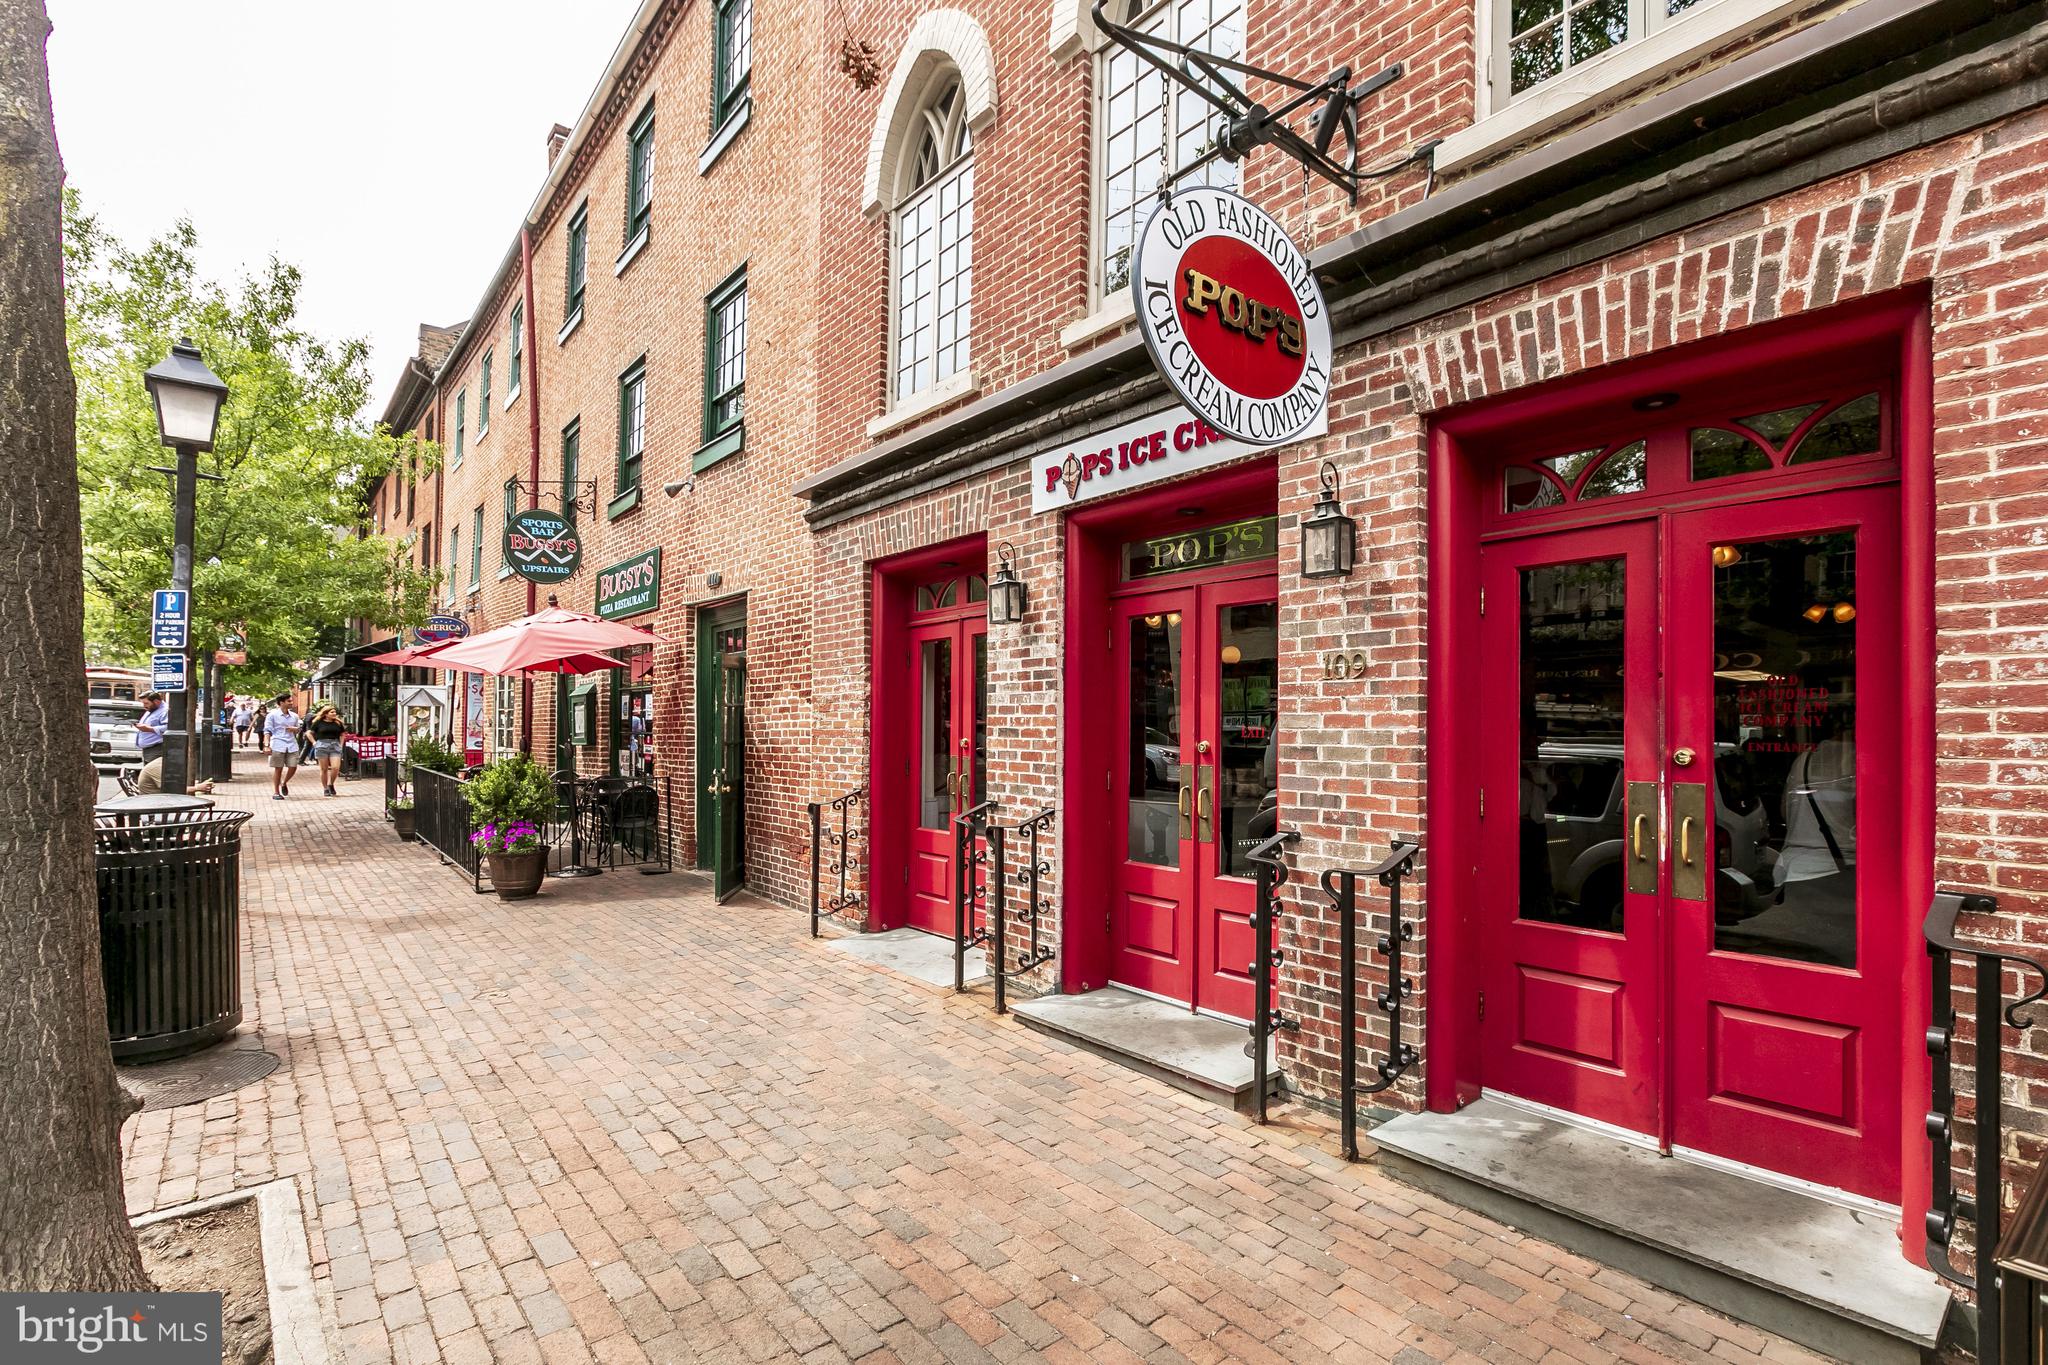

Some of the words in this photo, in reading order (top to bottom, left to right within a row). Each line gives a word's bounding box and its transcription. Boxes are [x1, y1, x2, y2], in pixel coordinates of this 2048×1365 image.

[1162, 199, 1206, 250] OLD
[1214, 197, 1320, 321] FASHIONED
[1184, 268, 1304, 356] POP'S
[1144, 276, 1179, 344] ICE
[1169, 340, 1243, 434] CREAM
[1249, 351, 1328, 438] COMPANY
[1118, 430, 1167, 471] ICE
[522, 518, 563, 530] SPORTS
[531, 527, 555, 536] BAR
[509, 534, 578, 554] BUGSY'S
[1150, 525, 1264, 569] POP'S
[522, 565, 570, 574] UPSTAIRS
[600, 556, 654, 602] BUGSY'S
[614, 591, 650, 611] RESTAURANT
[1322, 651, 1367, 680] 109
[1741, 702, 1764, 713] ICE
[1770, 701, 1828, 713] CREAM
[1743, 715, 1822, 727] COMPANY
